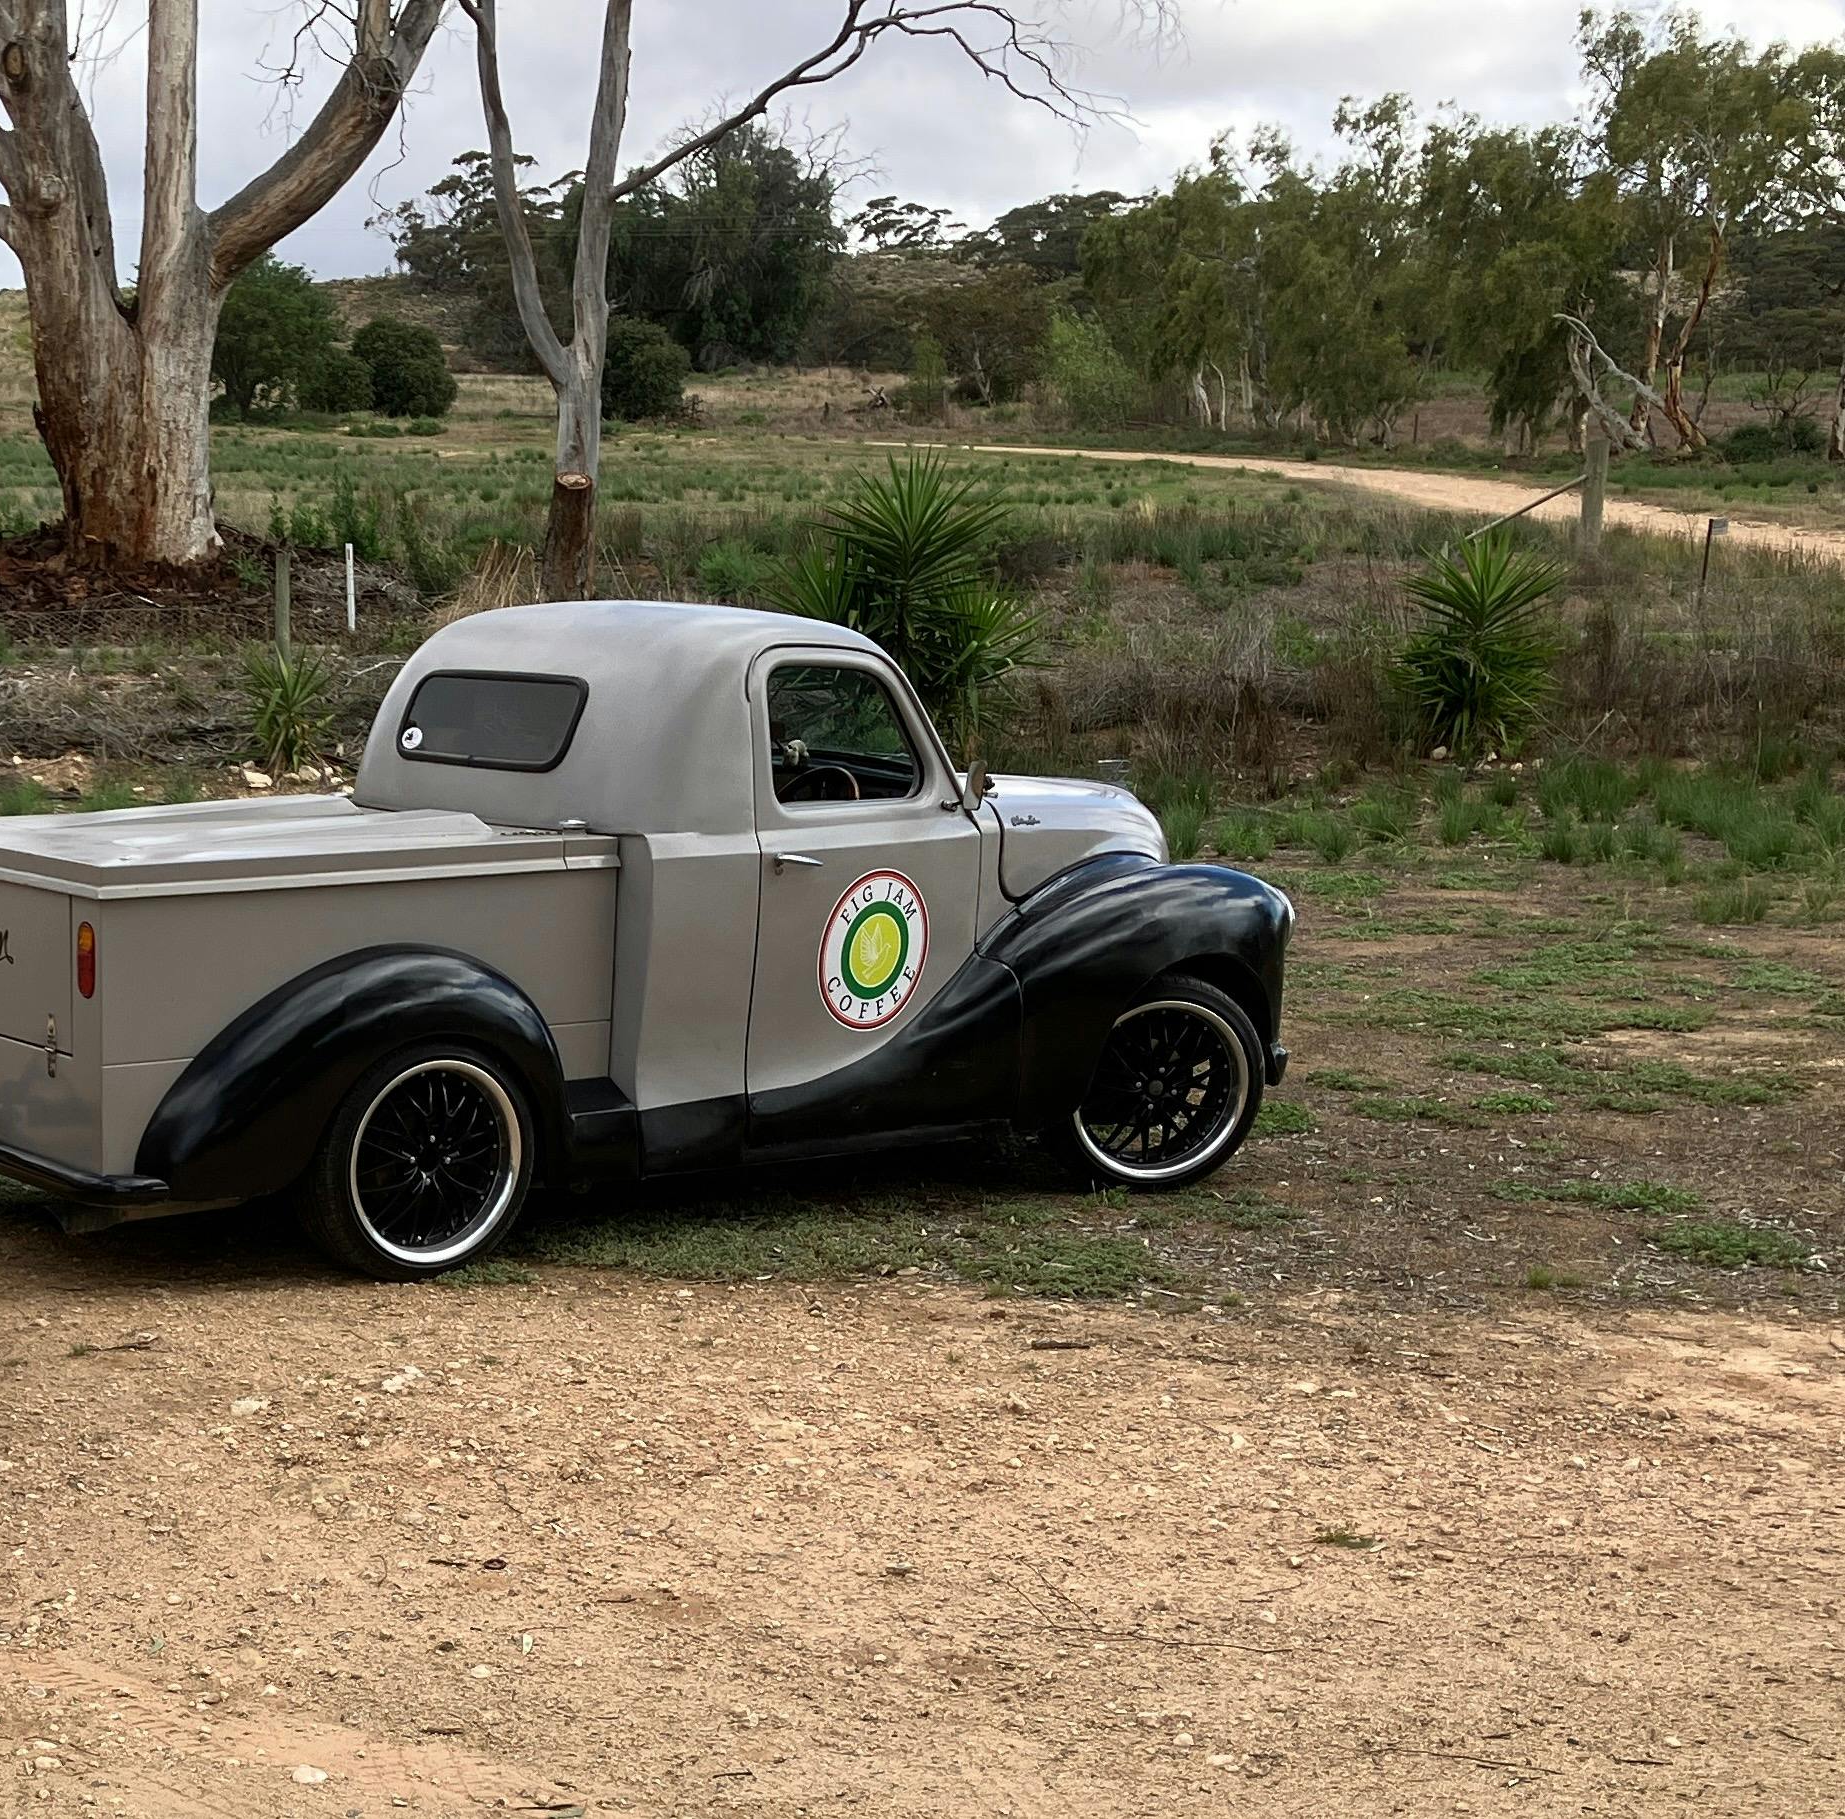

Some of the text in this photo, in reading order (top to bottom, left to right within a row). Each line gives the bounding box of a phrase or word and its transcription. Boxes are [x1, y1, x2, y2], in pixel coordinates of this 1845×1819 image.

[840, 882, 918, 924] FIG JAM
[827, 965, 916, 1019] COFFEE
